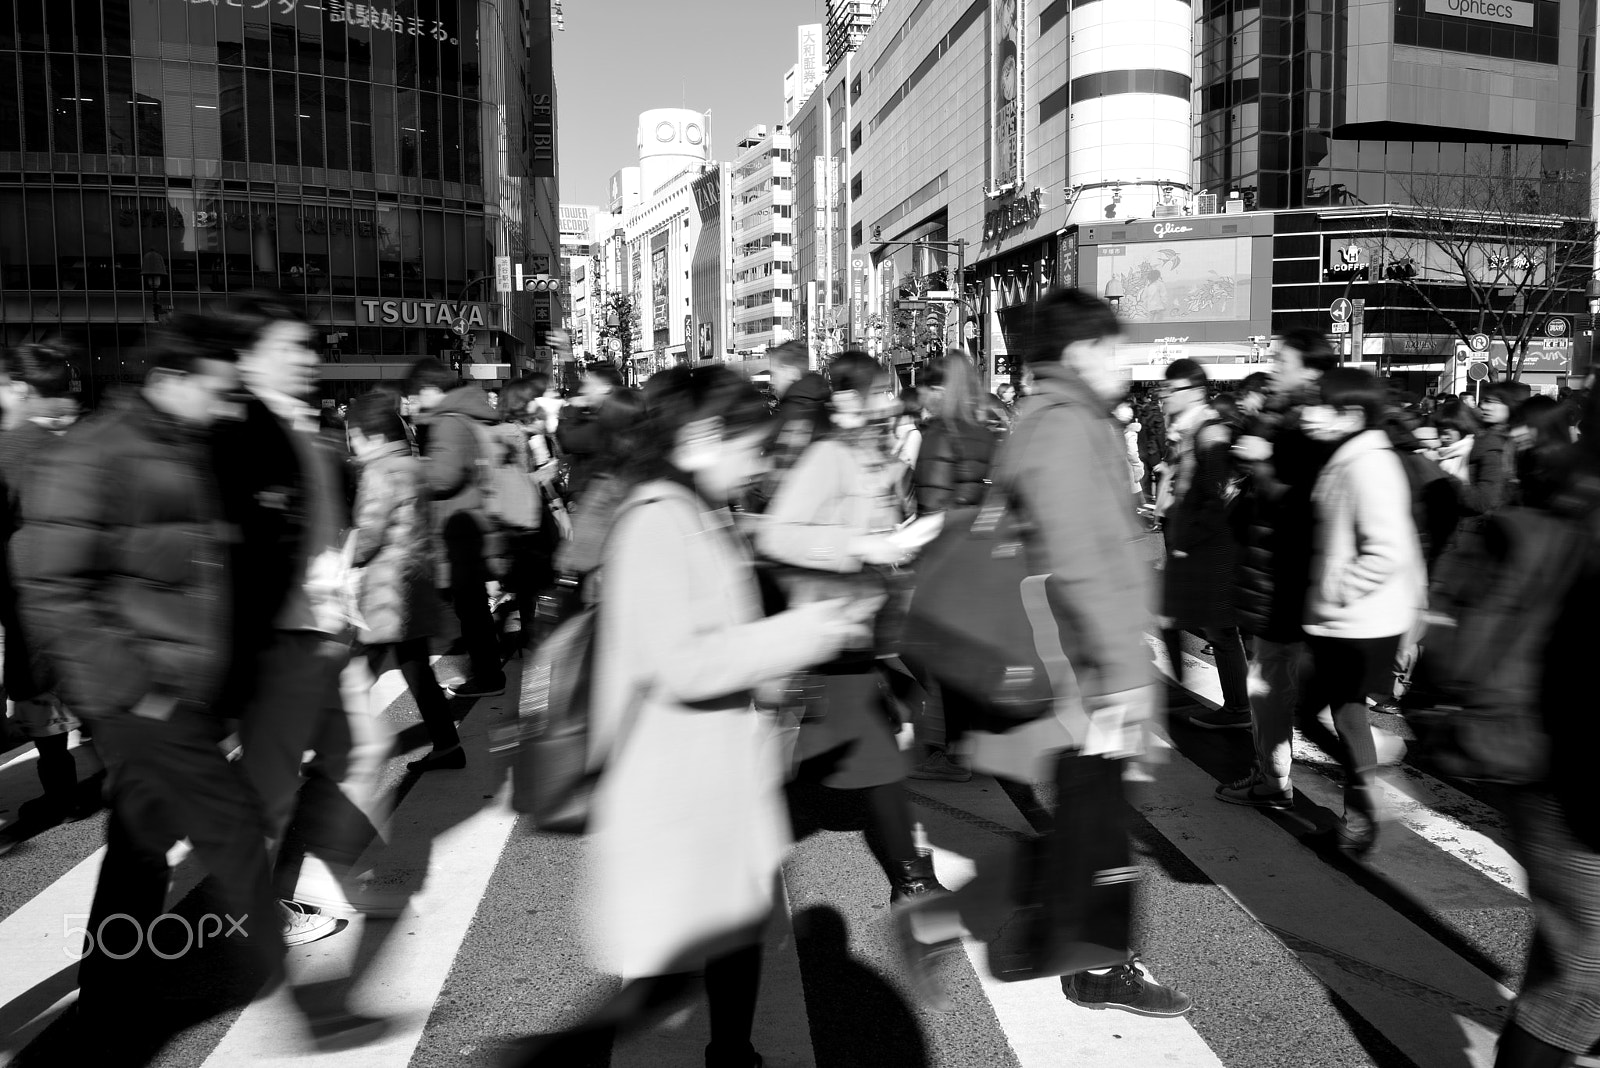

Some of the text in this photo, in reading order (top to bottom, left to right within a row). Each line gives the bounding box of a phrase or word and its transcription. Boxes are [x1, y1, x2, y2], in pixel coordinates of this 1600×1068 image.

[1447, 0, 1513, 19] Ophtecs
[803, 30, 817, 84] 大和証券
[533, 93, 552, 160] SEIBU
[559, 206, 588, 219] TOWER
[1153, 223, 1193, 239] Glico
[1349, 253, 1357, 262] H
[362, 299, 485, 326] TSUTAYA
